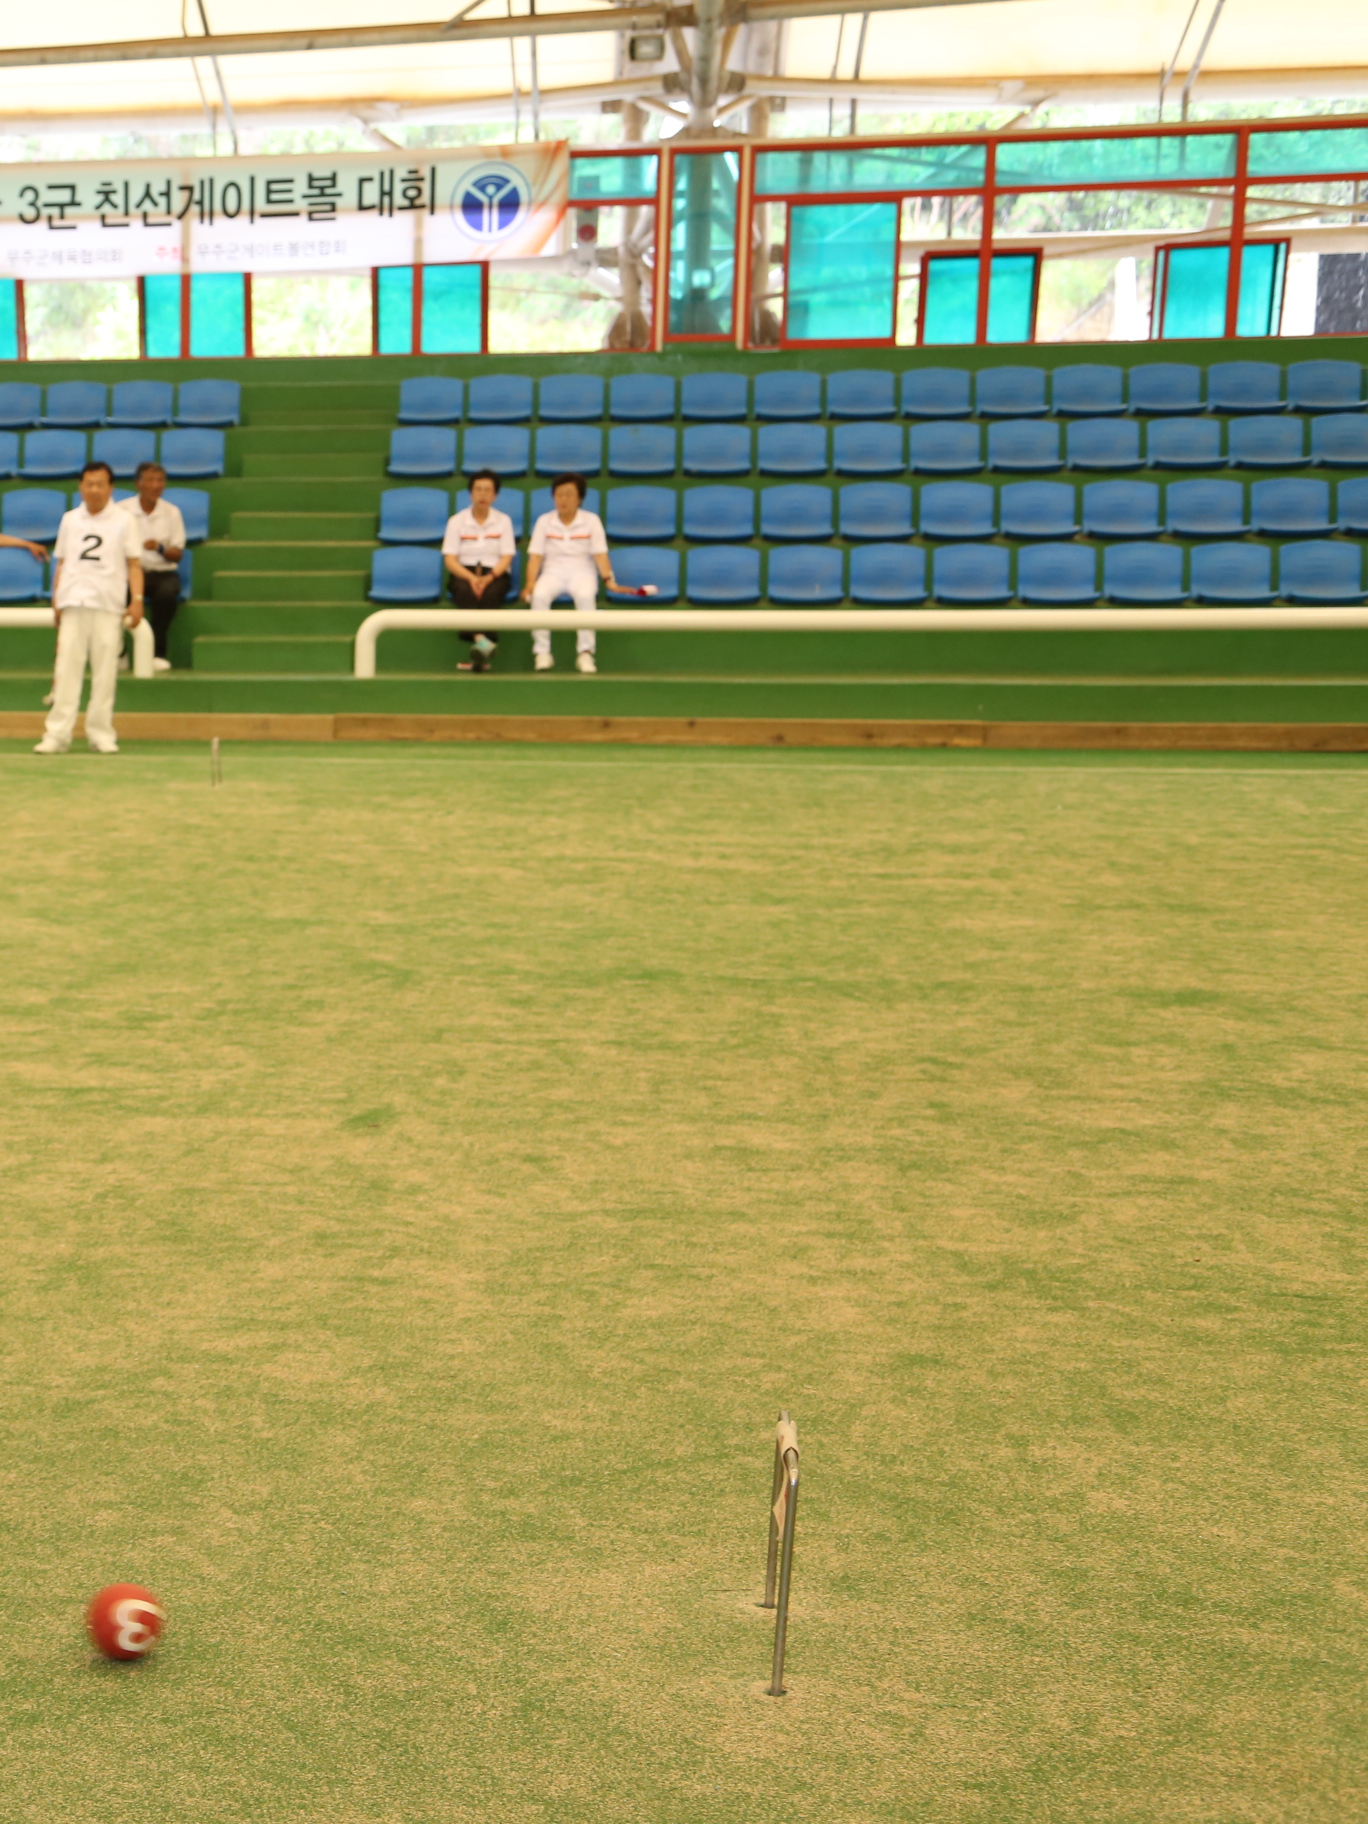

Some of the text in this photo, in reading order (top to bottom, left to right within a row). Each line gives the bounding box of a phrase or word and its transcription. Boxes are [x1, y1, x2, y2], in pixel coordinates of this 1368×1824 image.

[18, 183, 82, 230] 3군
[94, 171, 342, 228] 친선게이트볼
[357, 165, 437, 217] 대회
[79, 534, 103, 561] 2
